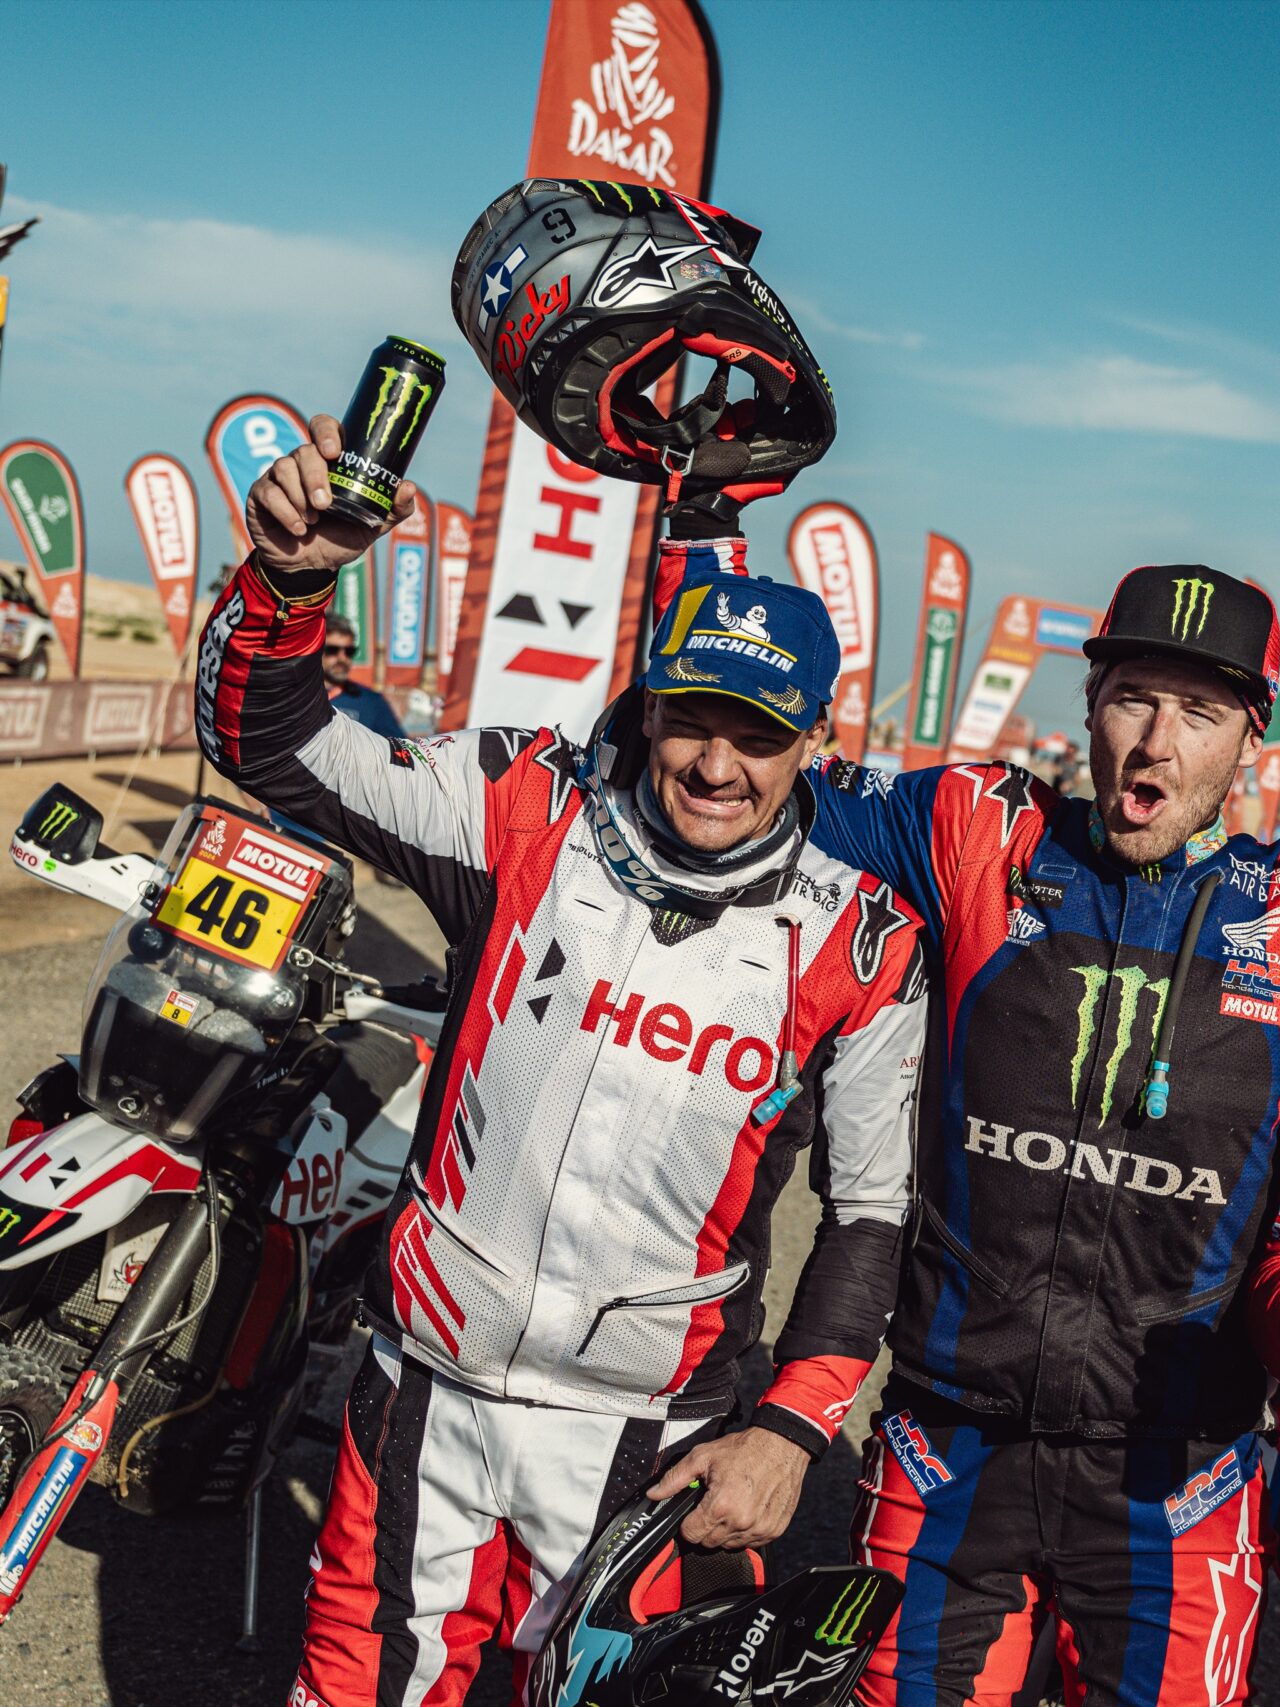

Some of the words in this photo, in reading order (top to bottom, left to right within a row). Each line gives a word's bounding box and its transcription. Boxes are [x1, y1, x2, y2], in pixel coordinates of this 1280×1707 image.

[566, 98, 676, 188] DAKAR
[337, 466, 392, 496] ENERGY
[685, 635, 796, 674] MICHELIN
[237, 844, 312, 887] MOTUL
[184, 874, 270, 950] 46
[171, 1008, 181, 1020] 8
[579, 978, 775, 1093] Hero
[1223, 996, 1279, 1022] MOTUL
[964, 1115, 1227, 1205] HONDA
[884, 1421, 902, 1457] Honda
[900, 1455, 928, 1494] RACING
[888, 1409, 953, 1490] HRC
[15, 1459, 75, 1555] MICHELIN
[1164, 1448, 1240, 1529] HRC
[1174, 1506, 1210, 1534] Honda
[1208, 1479, 1243, 1508] RACING
[730, 1607, 777, 1677] Hero
